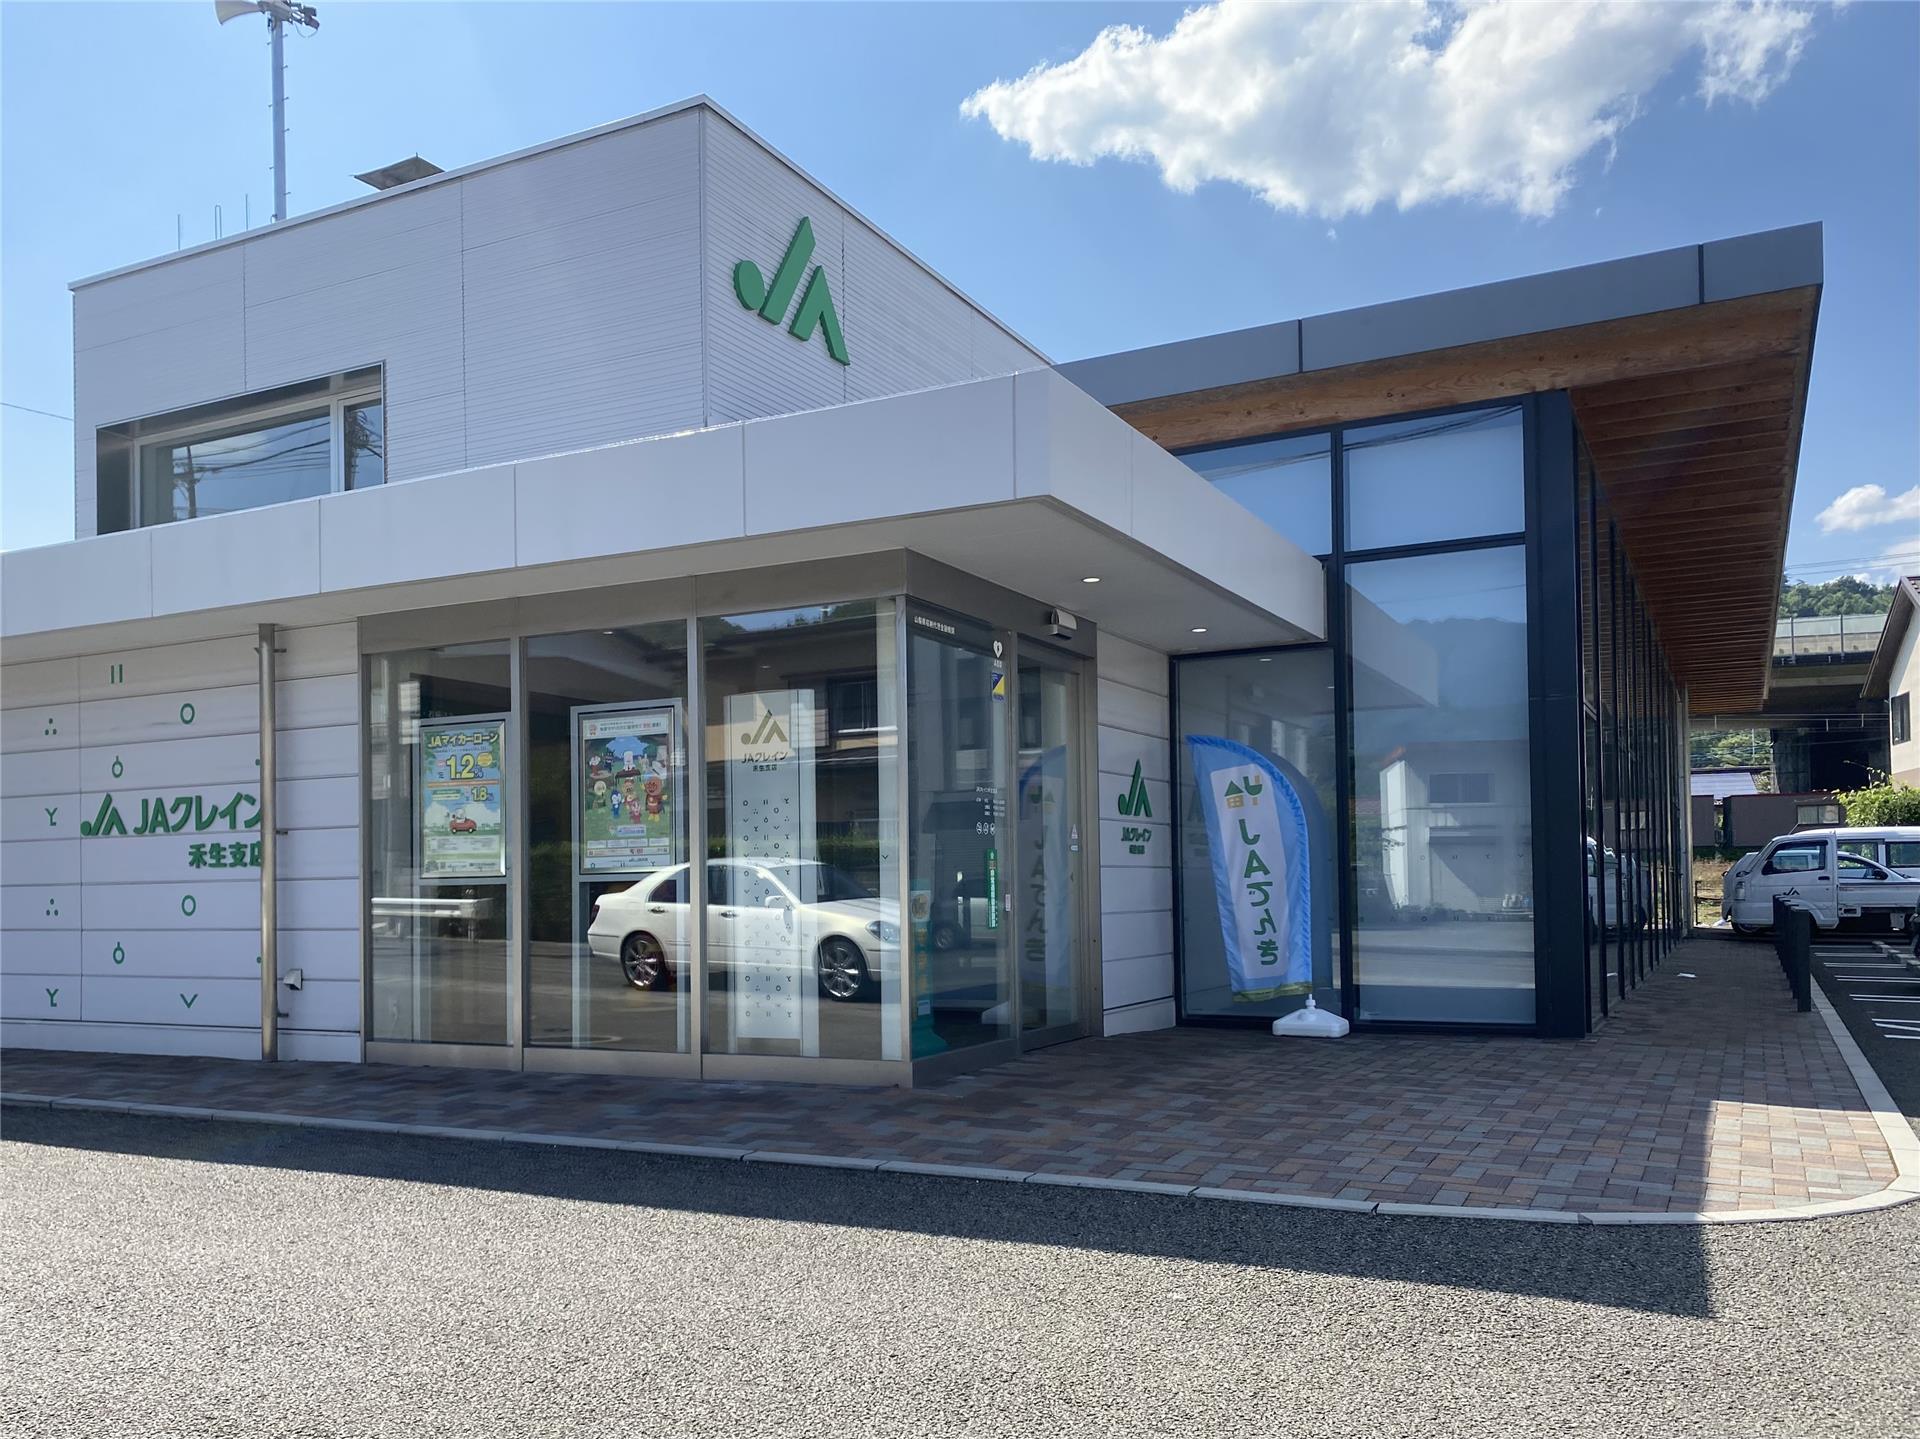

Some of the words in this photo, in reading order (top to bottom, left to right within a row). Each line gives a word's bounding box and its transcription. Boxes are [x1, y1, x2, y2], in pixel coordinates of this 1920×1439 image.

[428, 732, 499, 748] JAマイカーローン
[742, 751, 788, 764] JAクレイン
[133, 792, 262, 835] JAクレイン
